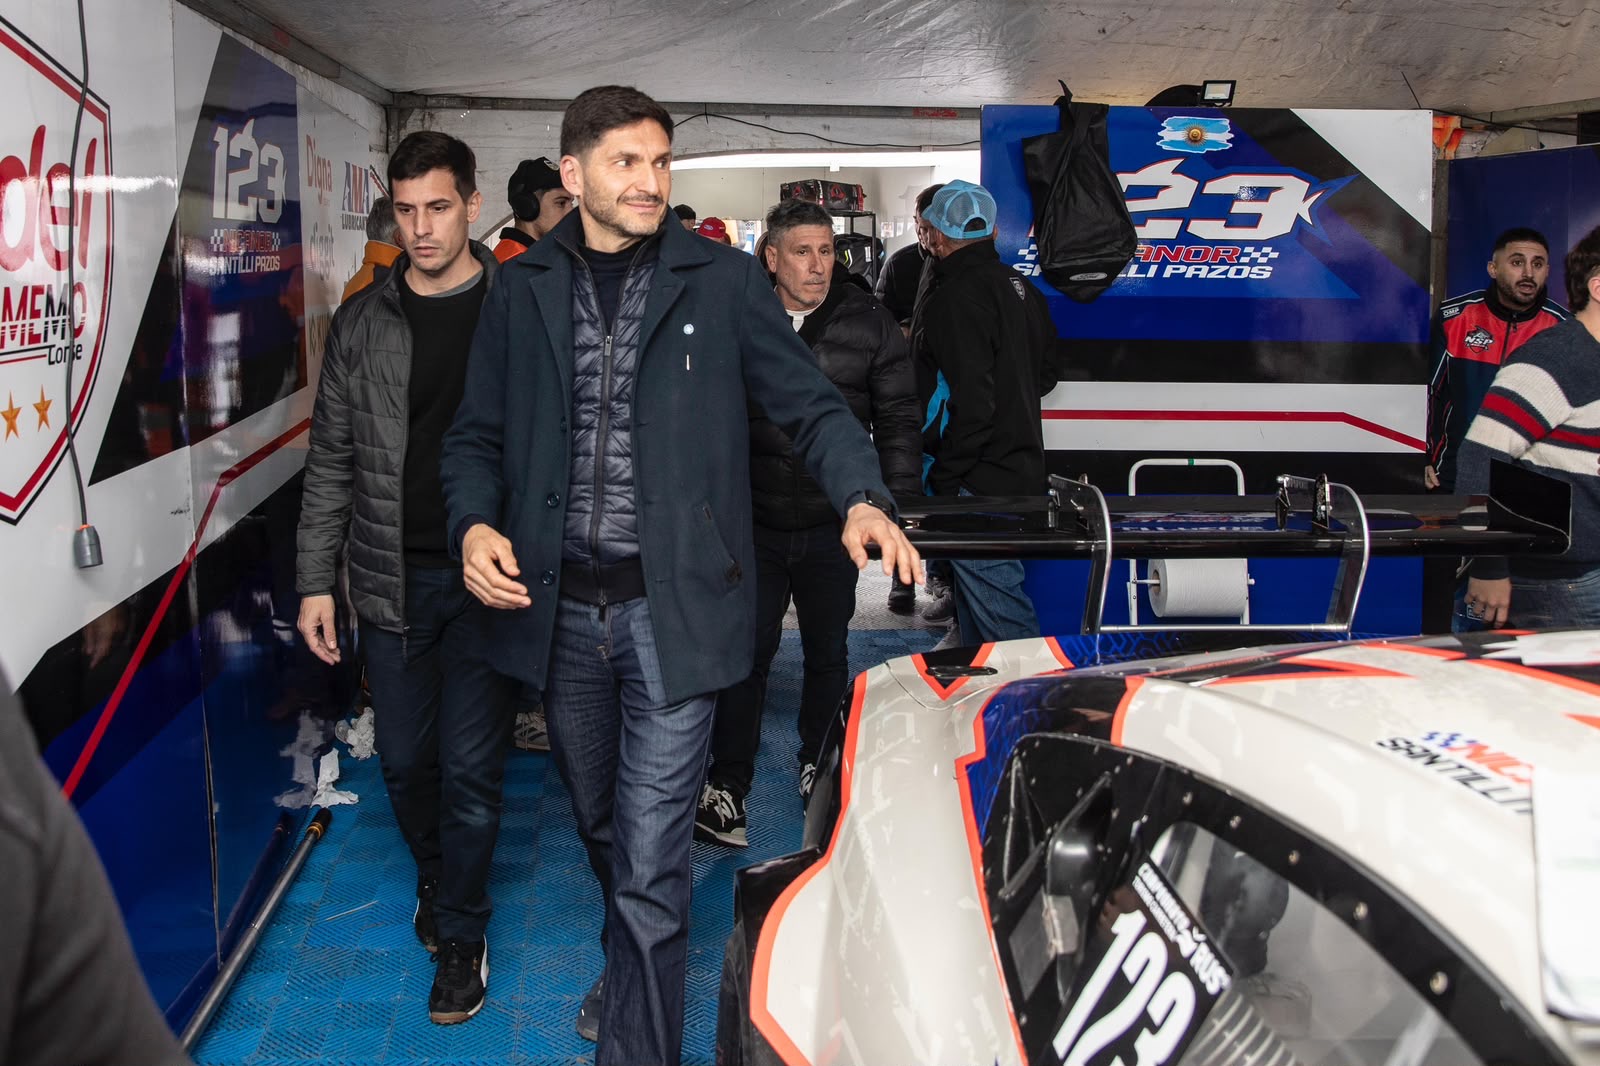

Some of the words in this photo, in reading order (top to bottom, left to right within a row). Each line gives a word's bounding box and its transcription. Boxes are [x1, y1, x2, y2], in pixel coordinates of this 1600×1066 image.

[213, 118, 287, 224] 123
[306, 134, 332, 204] Digna
[1114, 157, 1327, 241] 23
[341, 213, 369, 231] LUBRICAN
[223, 228, 272, 253] NICANOR
[209, 255, 254, 277] SANTILLI
[255, 255, 280, 273] PAZOS
[1134, 245, 1241, 264] ANOR
[1162, 264, 1274, 279] PAZOS
[1465, 336, 1494, 345] NSP
[1052, 909, 1196, 1066] 123
